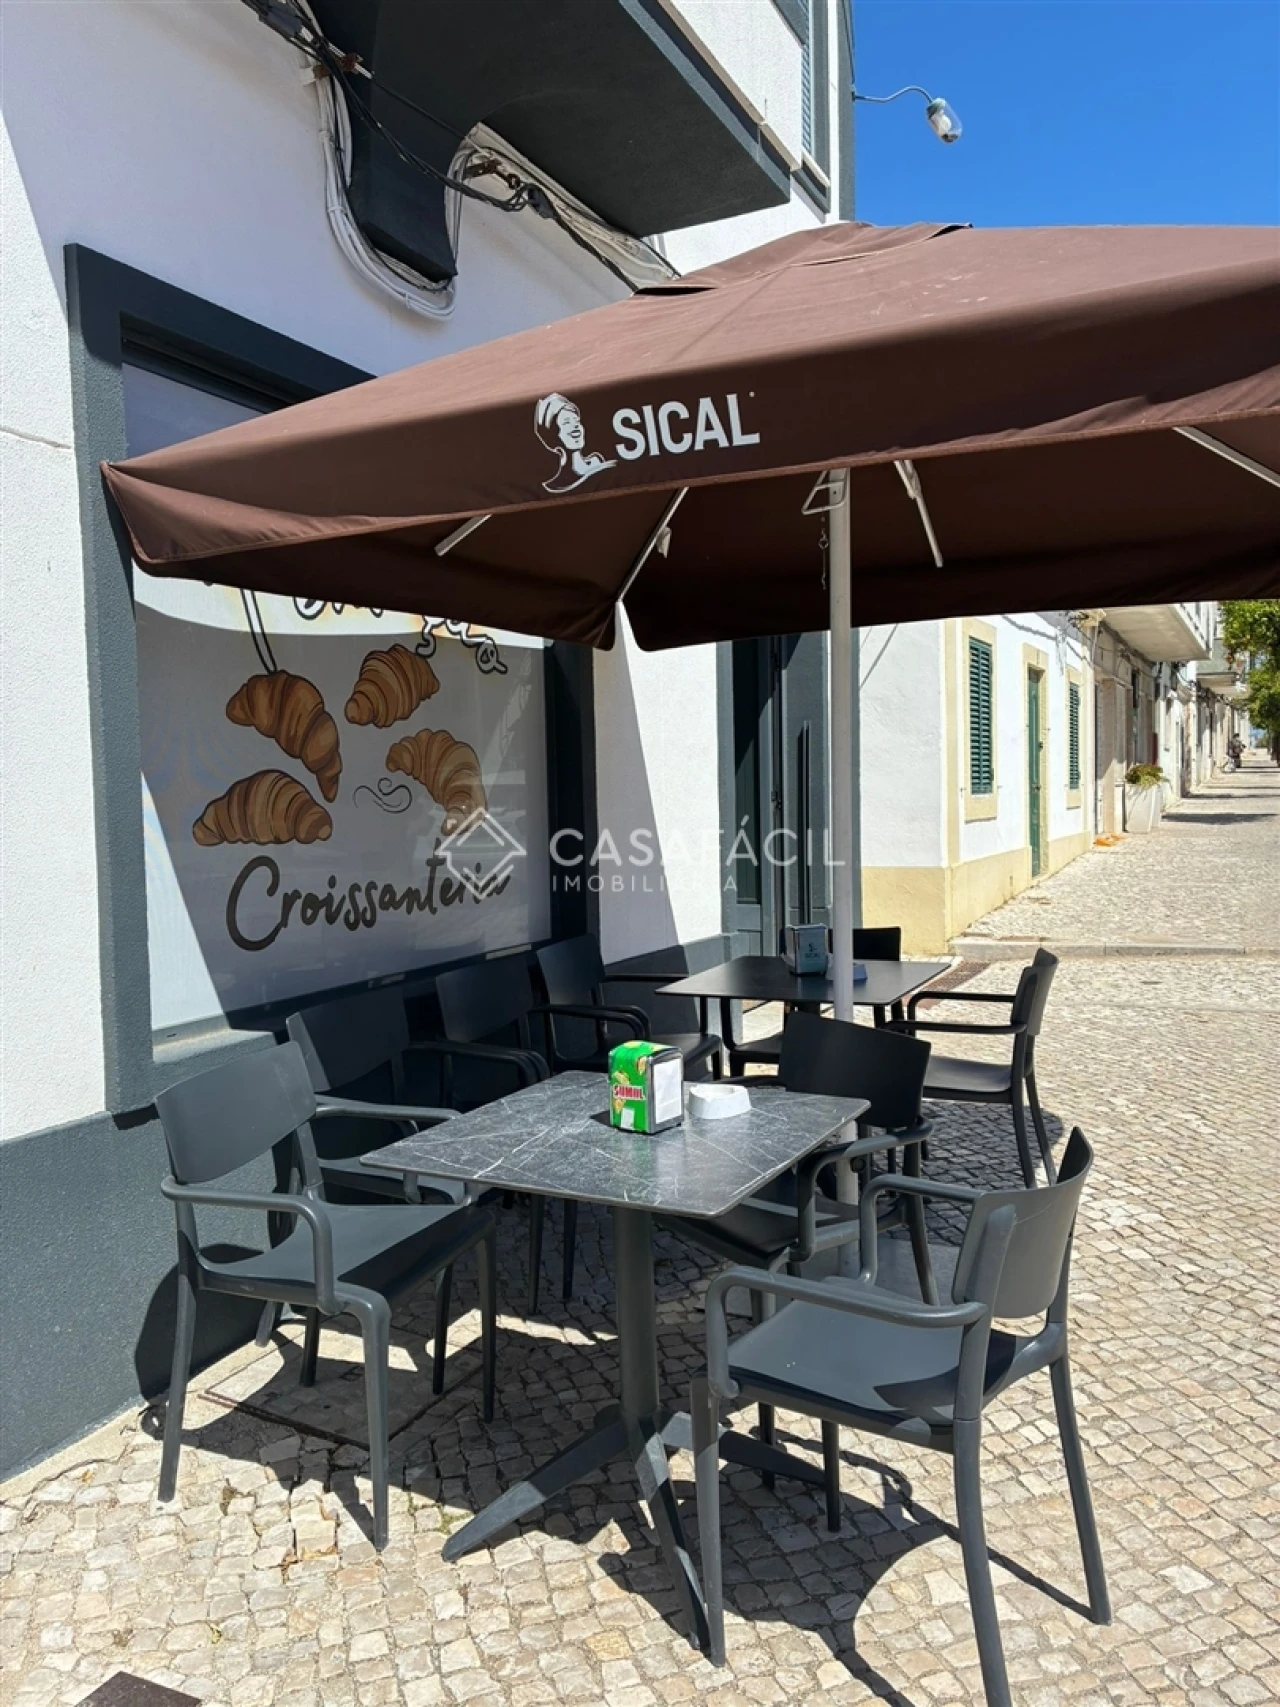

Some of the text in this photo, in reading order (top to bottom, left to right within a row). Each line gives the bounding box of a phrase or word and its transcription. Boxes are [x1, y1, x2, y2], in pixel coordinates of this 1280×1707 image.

[612, 393, 761, 461] SICAL
[225, 838, 512, 951] Croissanteria
[614, 1085, 643, 1099] SUMOL
